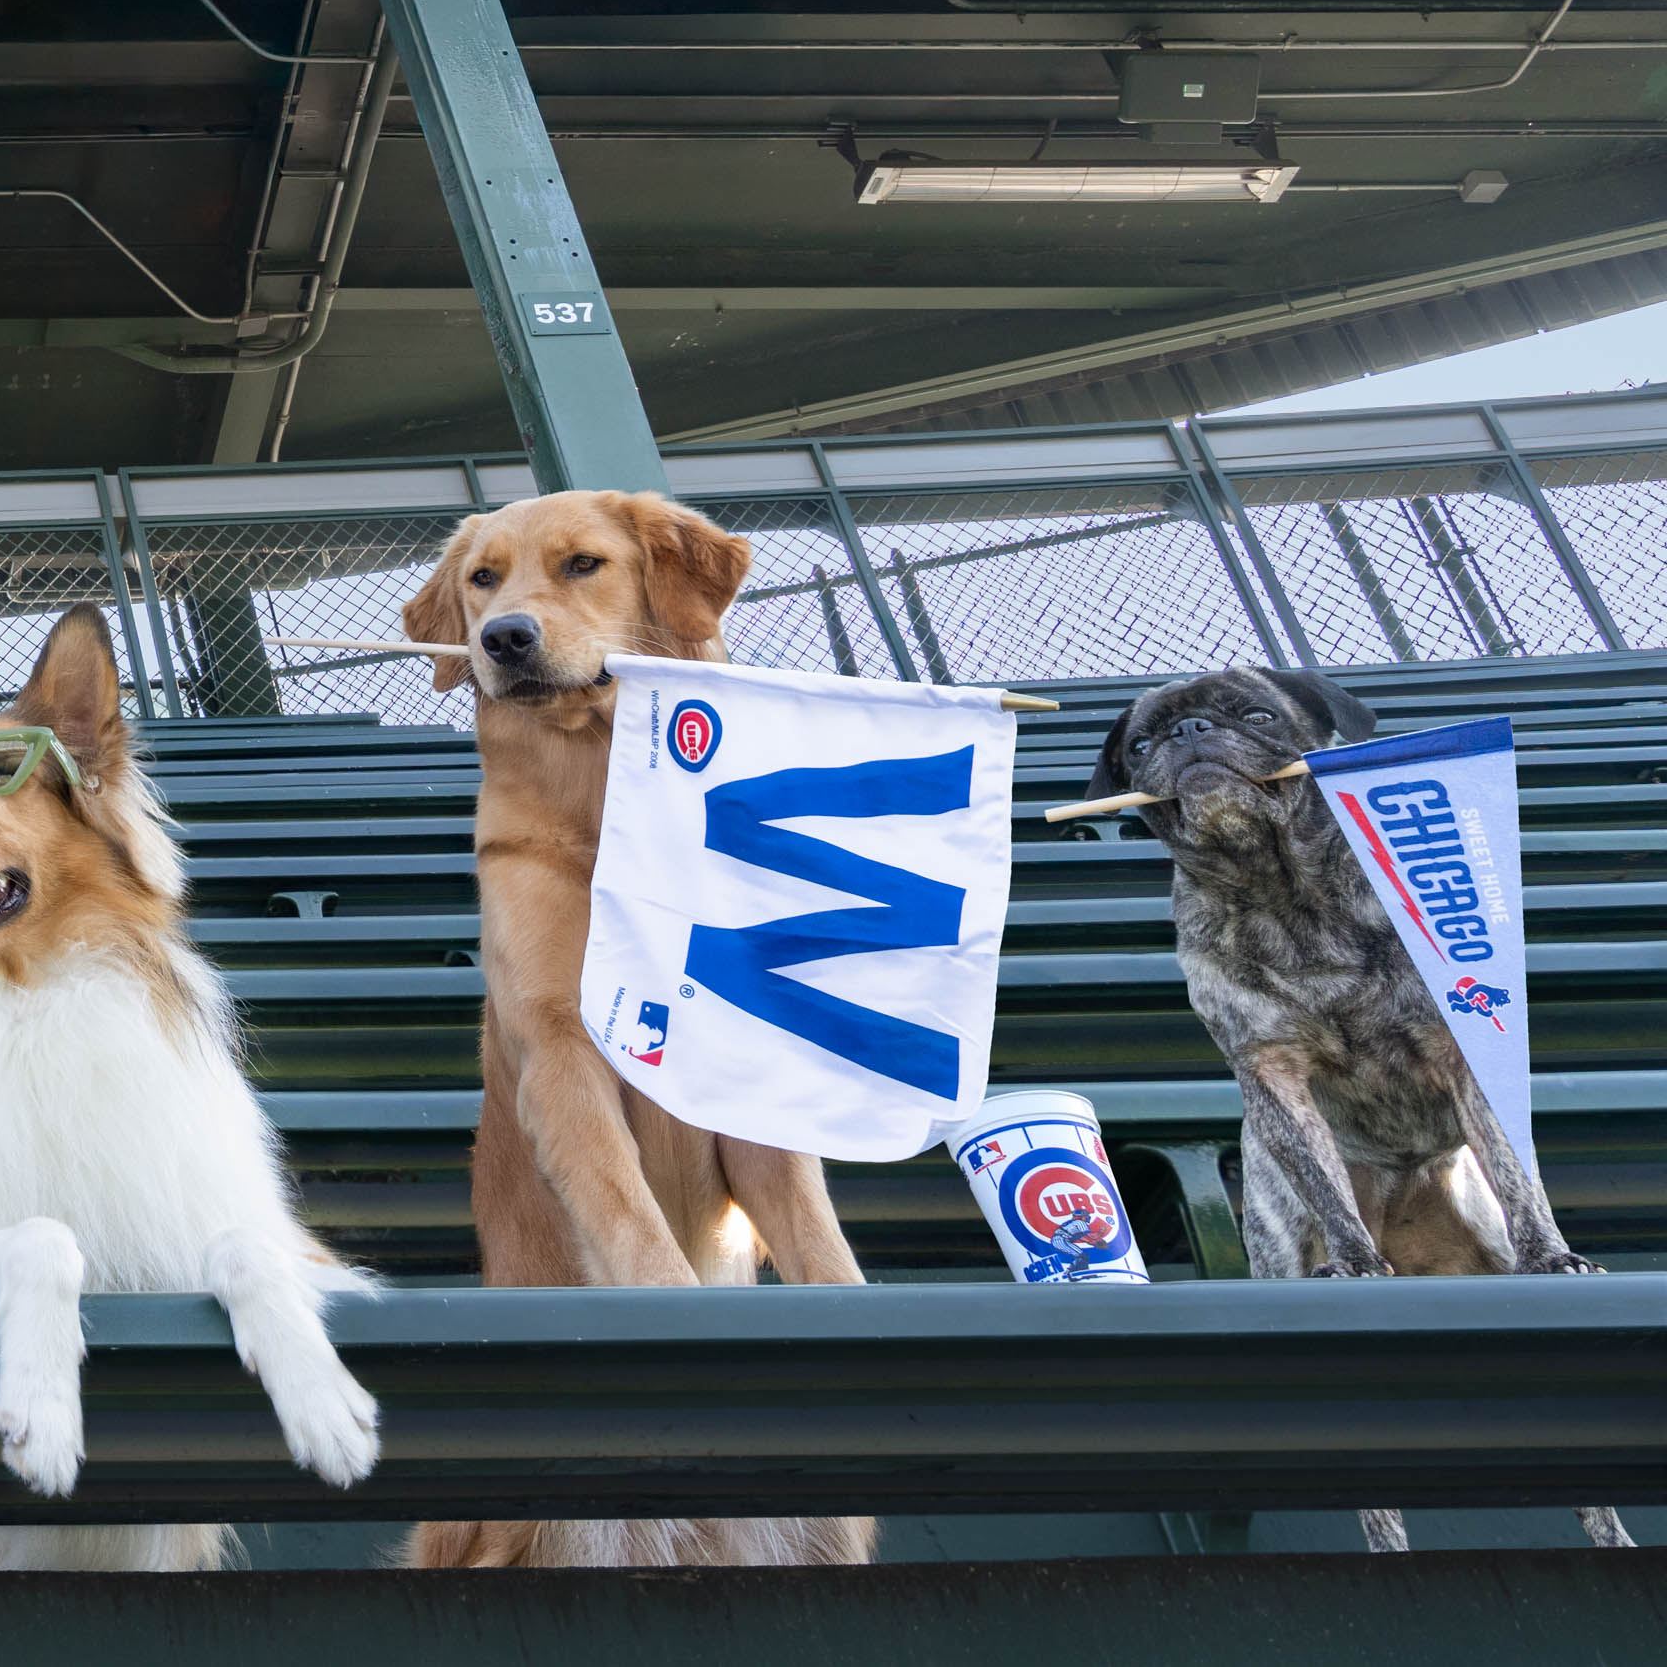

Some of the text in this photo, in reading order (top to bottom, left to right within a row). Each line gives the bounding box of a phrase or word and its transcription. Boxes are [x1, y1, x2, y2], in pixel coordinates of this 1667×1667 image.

[534, 301, 594, 325] 537
[684, 744, 975, 1101] W
[1367, 779, 1494, 963] CHICAGO
[1460, 807, 1511, 925] SWEET HOME
